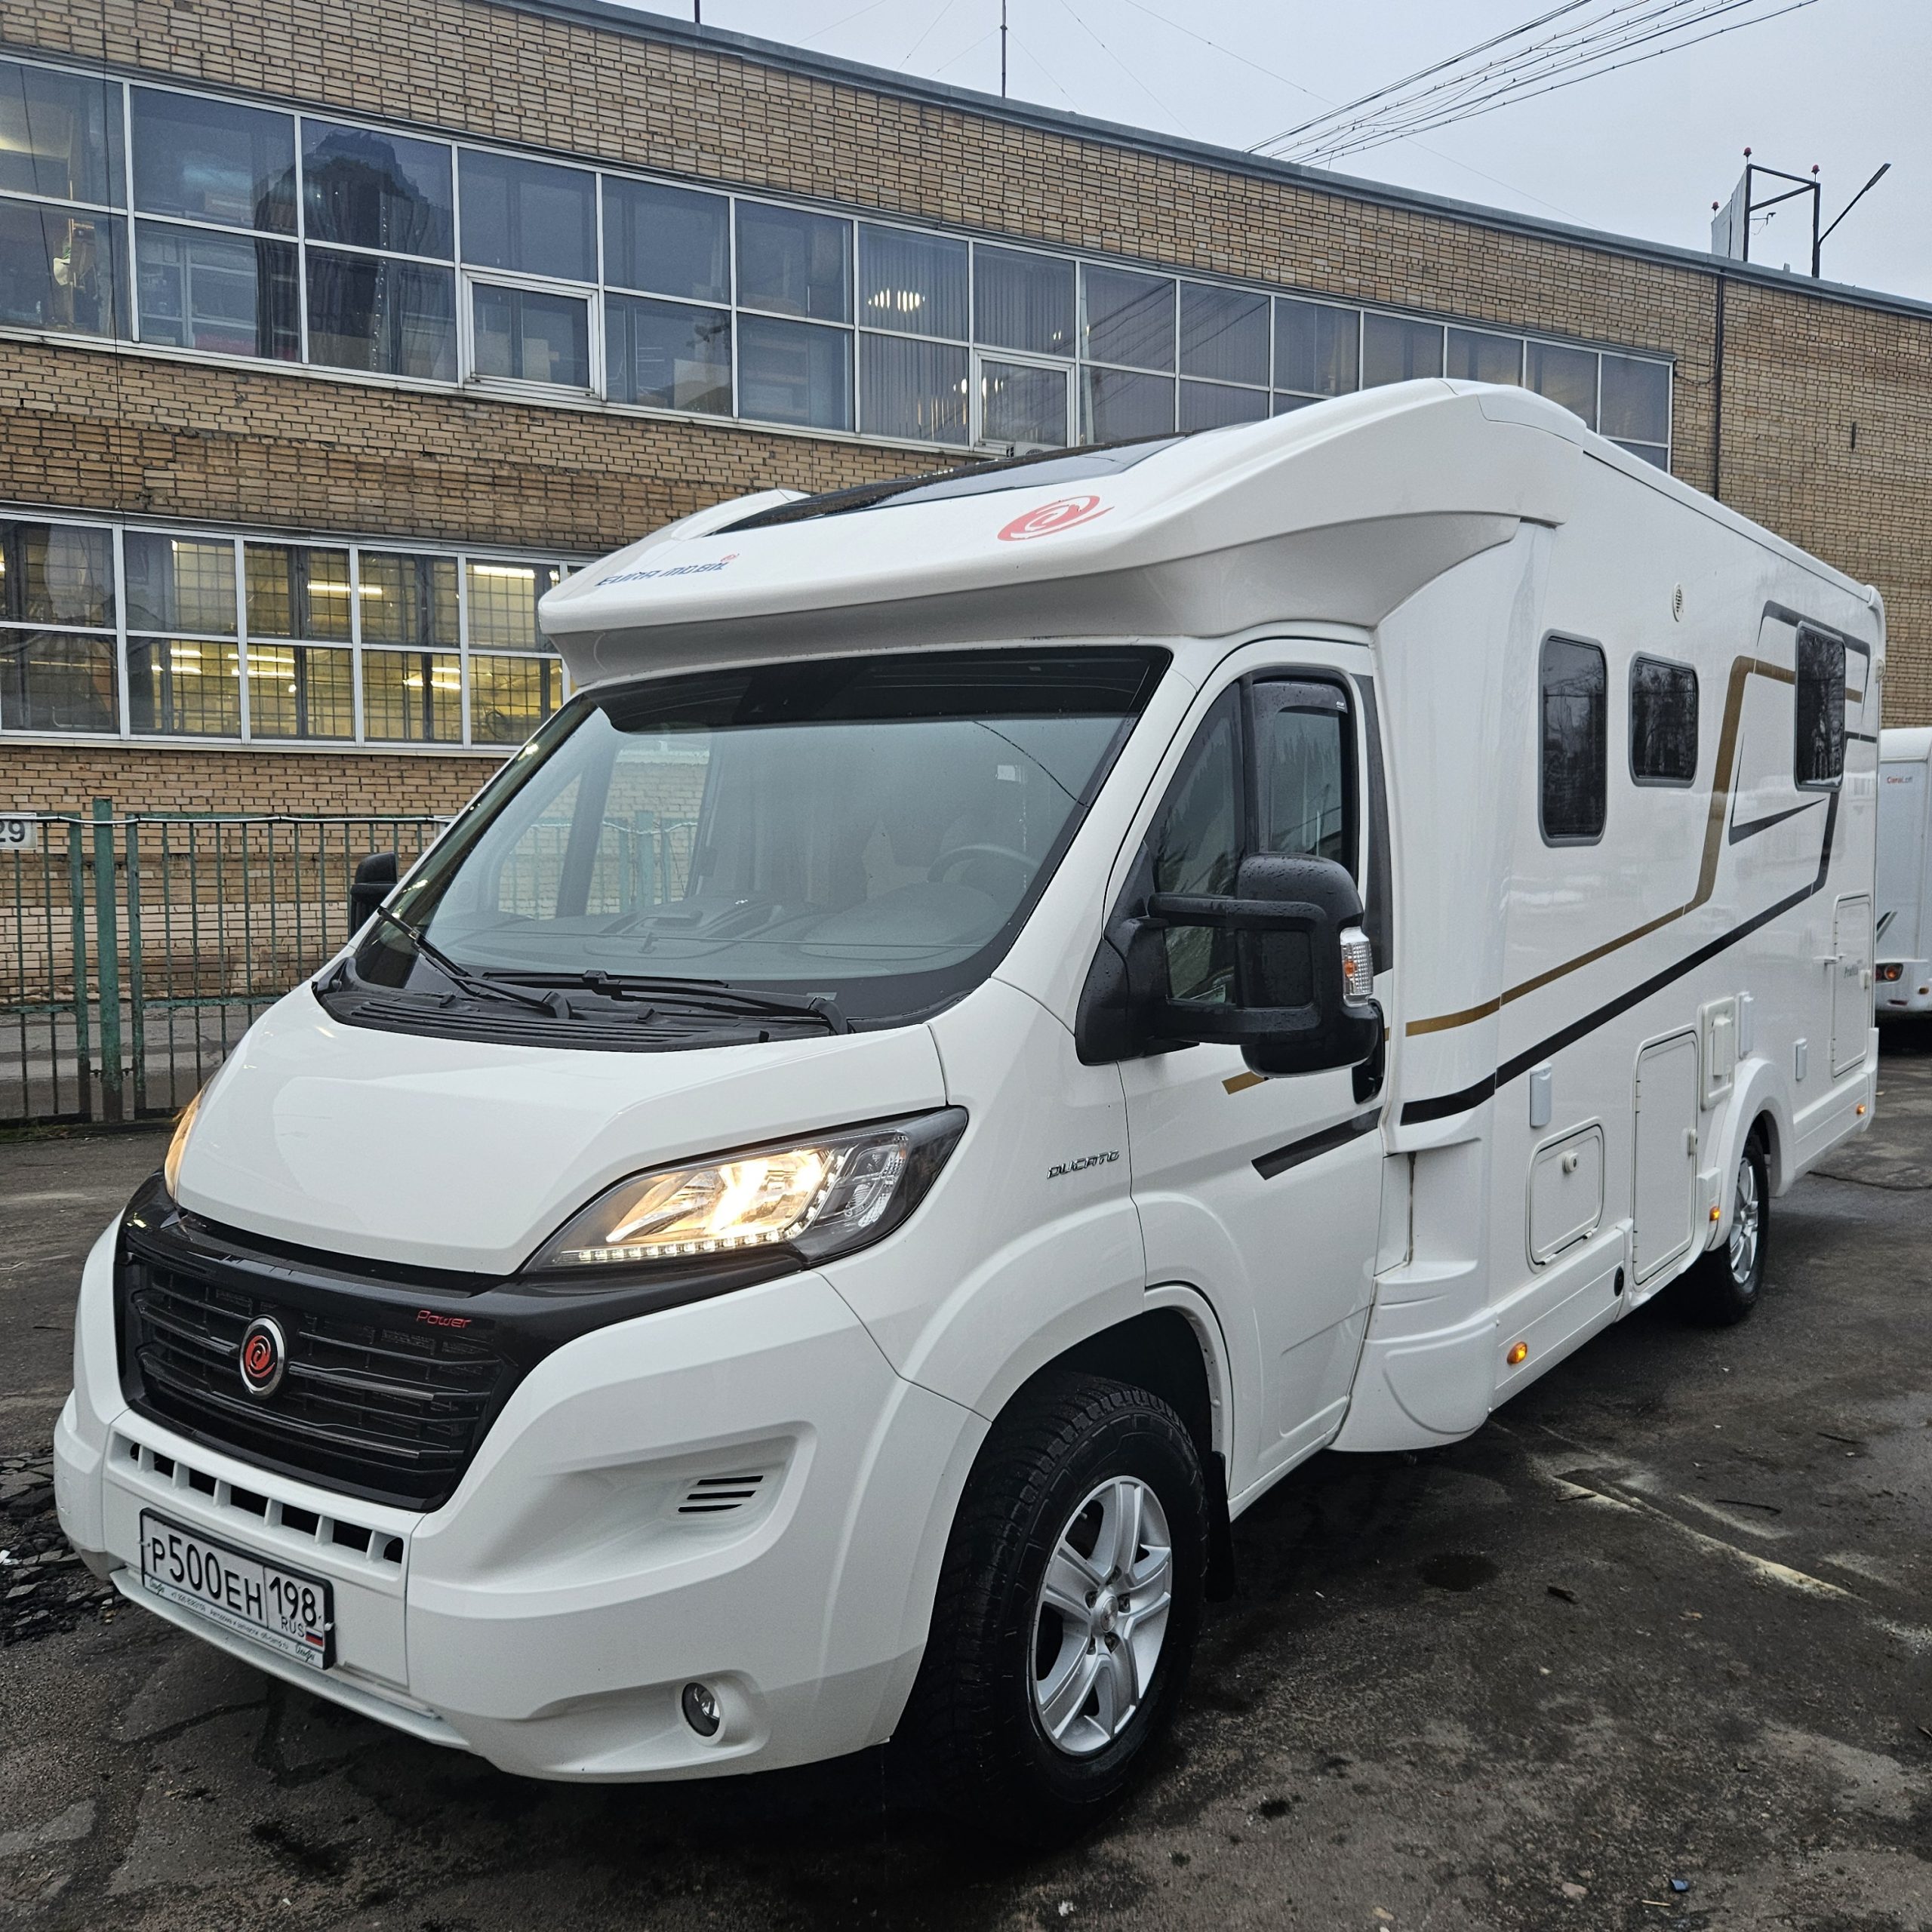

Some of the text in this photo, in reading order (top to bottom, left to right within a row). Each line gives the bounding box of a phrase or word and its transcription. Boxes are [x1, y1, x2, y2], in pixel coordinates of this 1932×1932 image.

[1047, 1150, 1119, 1179] DUCATO
[417, 1310, 472, 1328] Power
[269, 1577, 316, 1627] 198
[281, 1616, 305, 1638] RUS
